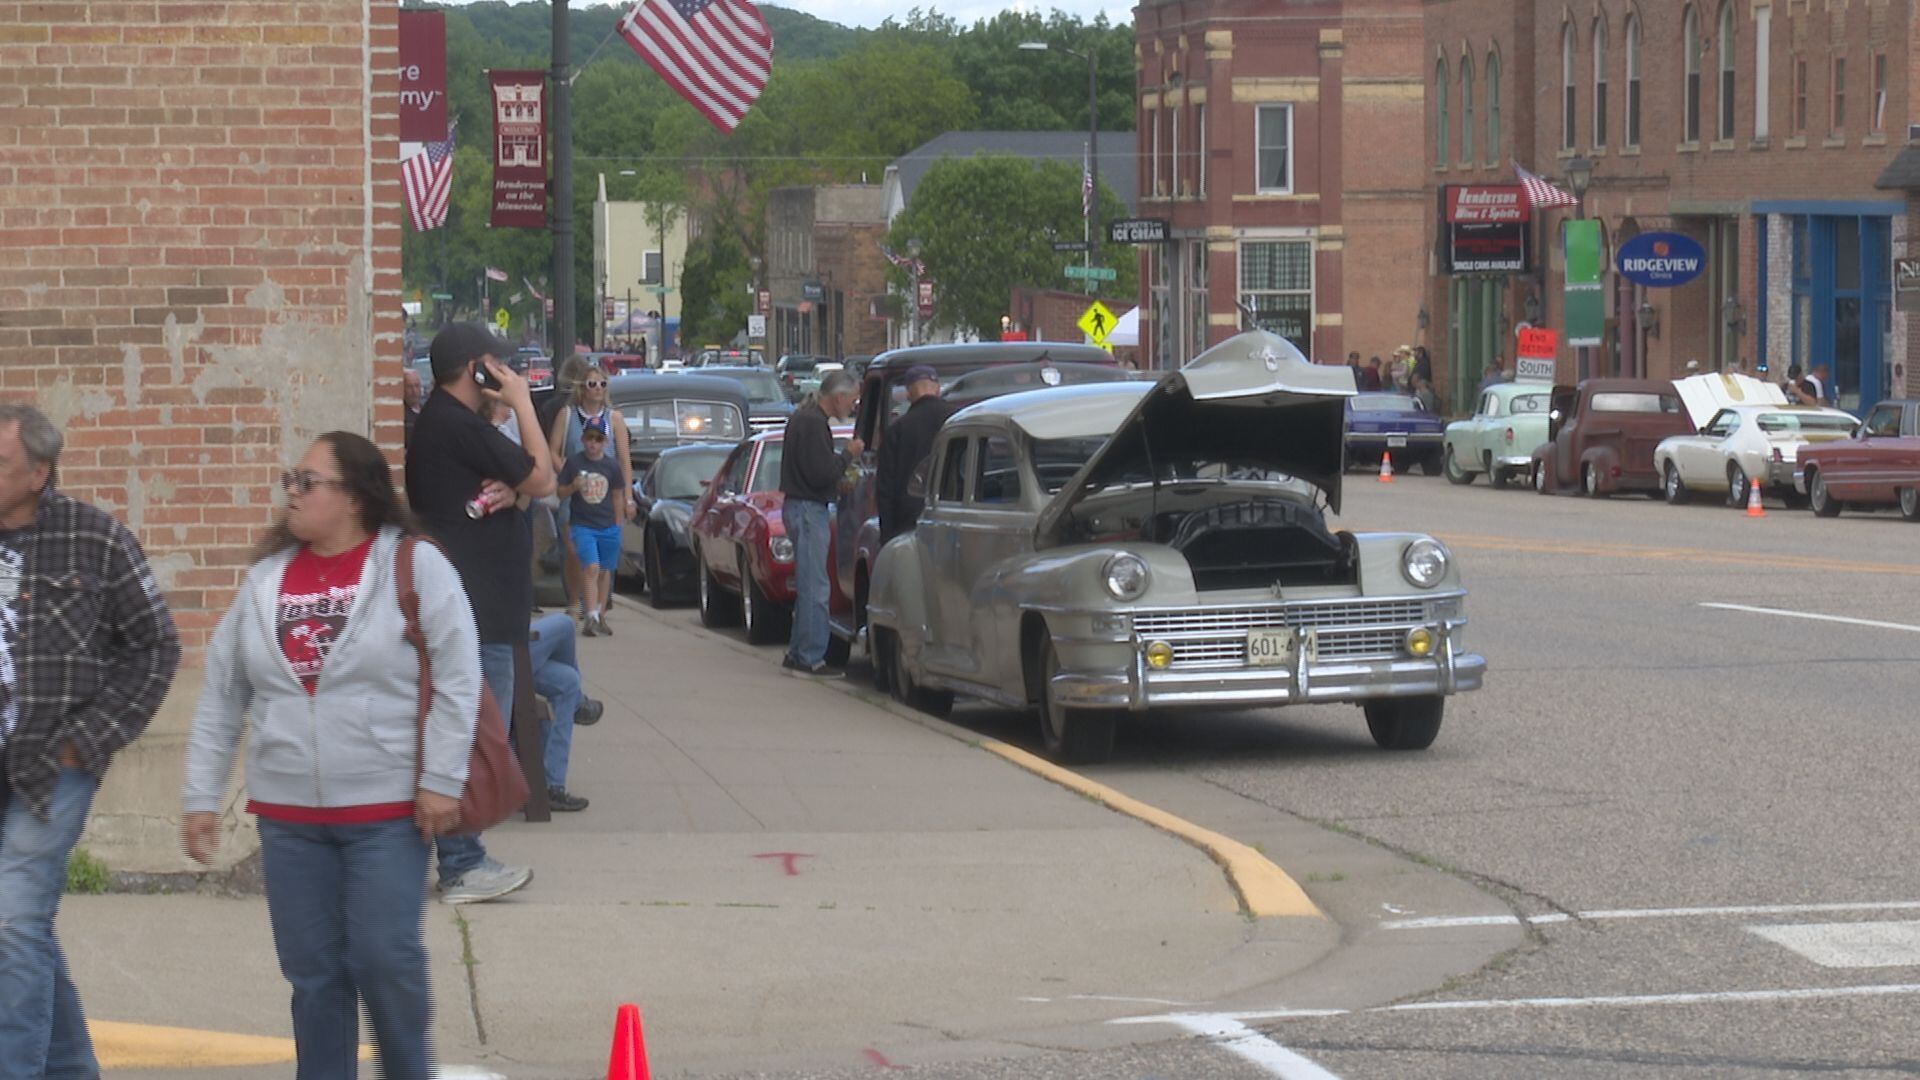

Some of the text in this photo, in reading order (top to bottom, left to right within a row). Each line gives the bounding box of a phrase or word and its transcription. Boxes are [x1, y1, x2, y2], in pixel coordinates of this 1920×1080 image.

[496, 180, 545, 189] Henderson
[505, 190, 534, 200] on the
[1459, 187, 1517, 204] Henderson
[496, 202, 543, 211] Minnesota
[1489, 207, 1520, 220] Spirits
[1113, 228, 1163, 241] ICE CREAM
[1624, 258, 1698, 271] RIDGEVIEW
[751, 326, 764, 334] 30
[1519, 360, 1553, 374] SOUTH
